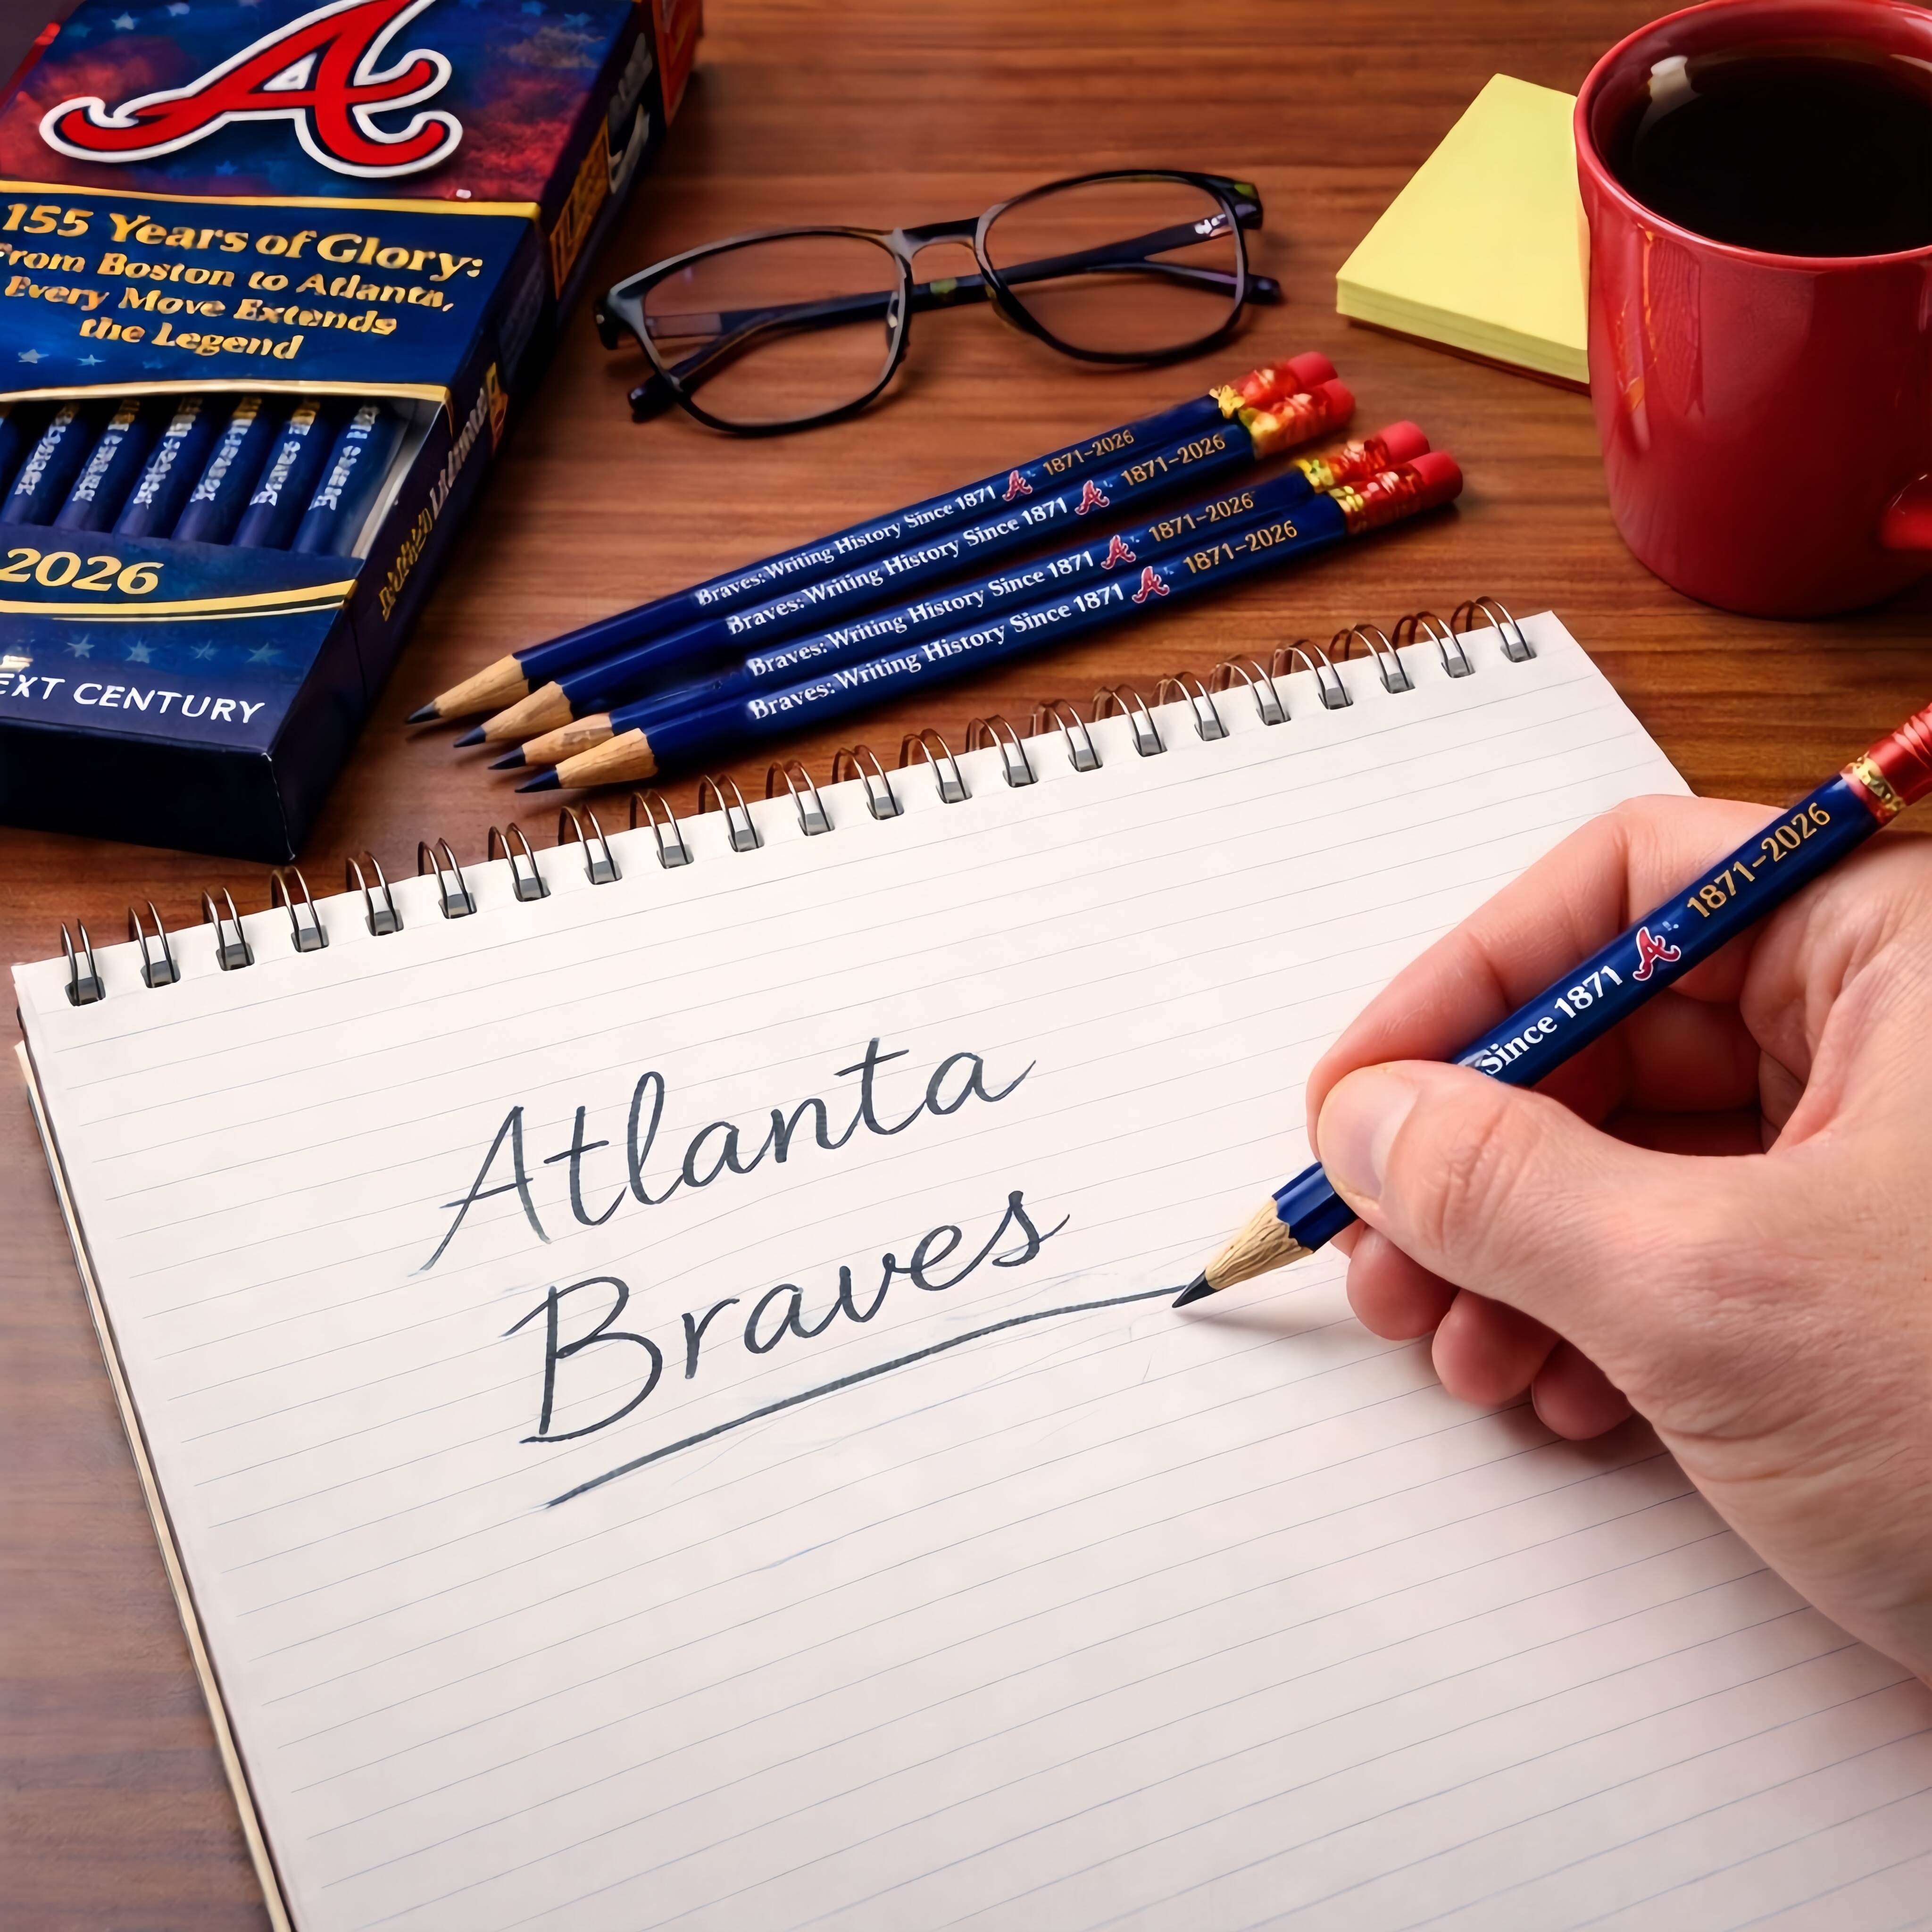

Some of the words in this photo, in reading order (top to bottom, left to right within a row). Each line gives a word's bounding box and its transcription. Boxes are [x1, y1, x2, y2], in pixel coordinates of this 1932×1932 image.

[2, 203, 93, 237] 155
[109, 213, 249, 252] Years
[255, 230, 317, 258] of
[317, 233, 483, 282] Glory:
[97, 252, 234, 287] Boston
[248, 271, 289, 291] to
[4, 275, 109, 311] Every
[118, 287, 225, 317] Move
[233, 299, 397, 335] Extends
[79, 316, 145, 343] the
[151, 322, 304, 359] Legend
[0, 548, 164, 594] 2026
[695, 572, 765, 606] Braves:
[763, 547, 834, 580] Writing
[834, 522, 901, 555] History
[903, 504, 953, 528] Since
[955, 485, 995, 510] 1871
[727, 597, 805, 635] Braves:
[802, 567, 883, 605] Writing
[883, 539, 959, 576] History
[963, 519, 1020, 547] Since
[1021, 497, 1068, 526] 1871
[746, 639, 828, 677] Braves:
[825, 613, 908, 650] Writing
[908, 588, 984, 624] History
[988, 569, 1045, 597] Since
[1047, 550, 1093, 580] 1871
[748, 681, 835, 720] Braves:
[833, 653, 921, 690] Writing
[921, 624, 1006, 662] History
[1009, 604, 1072, 633] Since
[1073, 583, 1124, 612] 1871
[73, 683, 265, 724] CENTURY
[1480, 1016, 1557, 1074] Since
[1555, 966, 1623, 1019] 1871
[1686, 802, 1831, 917] 1871-2026
[416, 1037, 1037, 1274] Atlanta
[500, 1191, 1071, 1443] Braves
